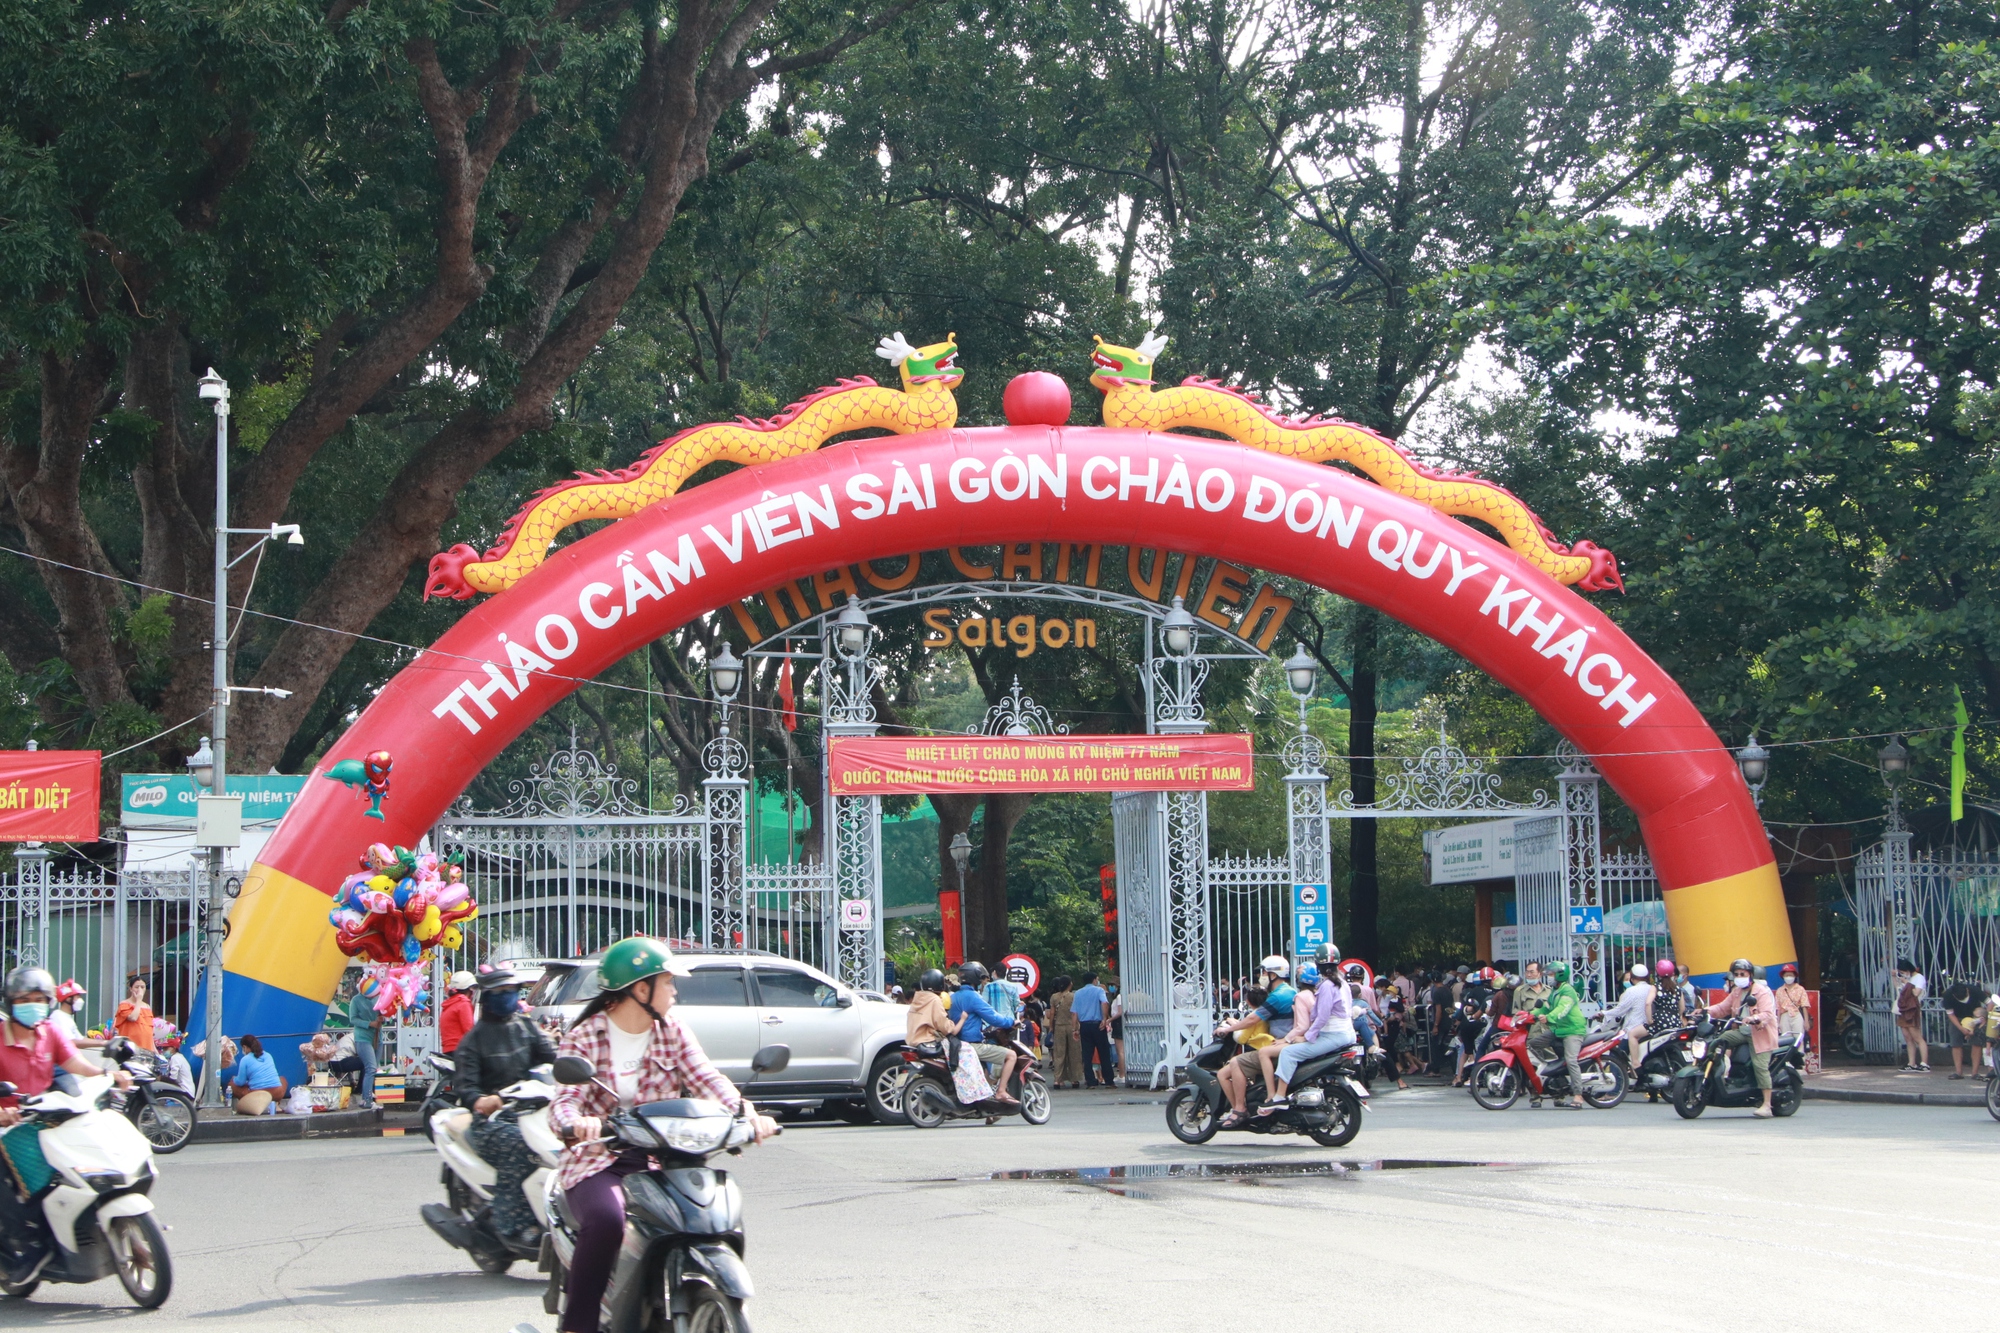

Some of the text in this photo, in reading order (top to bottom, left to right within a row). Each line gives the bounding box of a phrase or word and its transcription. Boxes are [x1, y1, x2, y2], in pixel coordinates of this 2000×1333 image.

[433, 449, 1657, 735] THẢO CẦM VIÊN SÀI GÒN CHÀO ĐÓN QUÝ KHÁCH
[922, 607, 1097, 658] Saigon
[906, 744, 946, 764] NHIỆT
[951, 744, 978, 763] LIỆT
[983, 742, 1020, 760] CHÀO
[1025, 743, 1065, 760] MỪNG
[1090, 742, 1125, 762] NIỆM
[1130, 745, 1146, 759] 77
[1150, 744, 1180, 759] NĂM
[842, 764, 1241, 786] QUỐC KHÁNH NƯỚC CỘNG HÒA XÃ HỘI CHỦ NGHĨA VIỆT NAM
[0, 780, 71, 813] BẤT DIỆT
[135, 791, 164, 803] MILO
[249, 790, 281, 806] NIỆM
[1299, 914, 1314, 937] P
[1571, 915, 1583, 932] P
